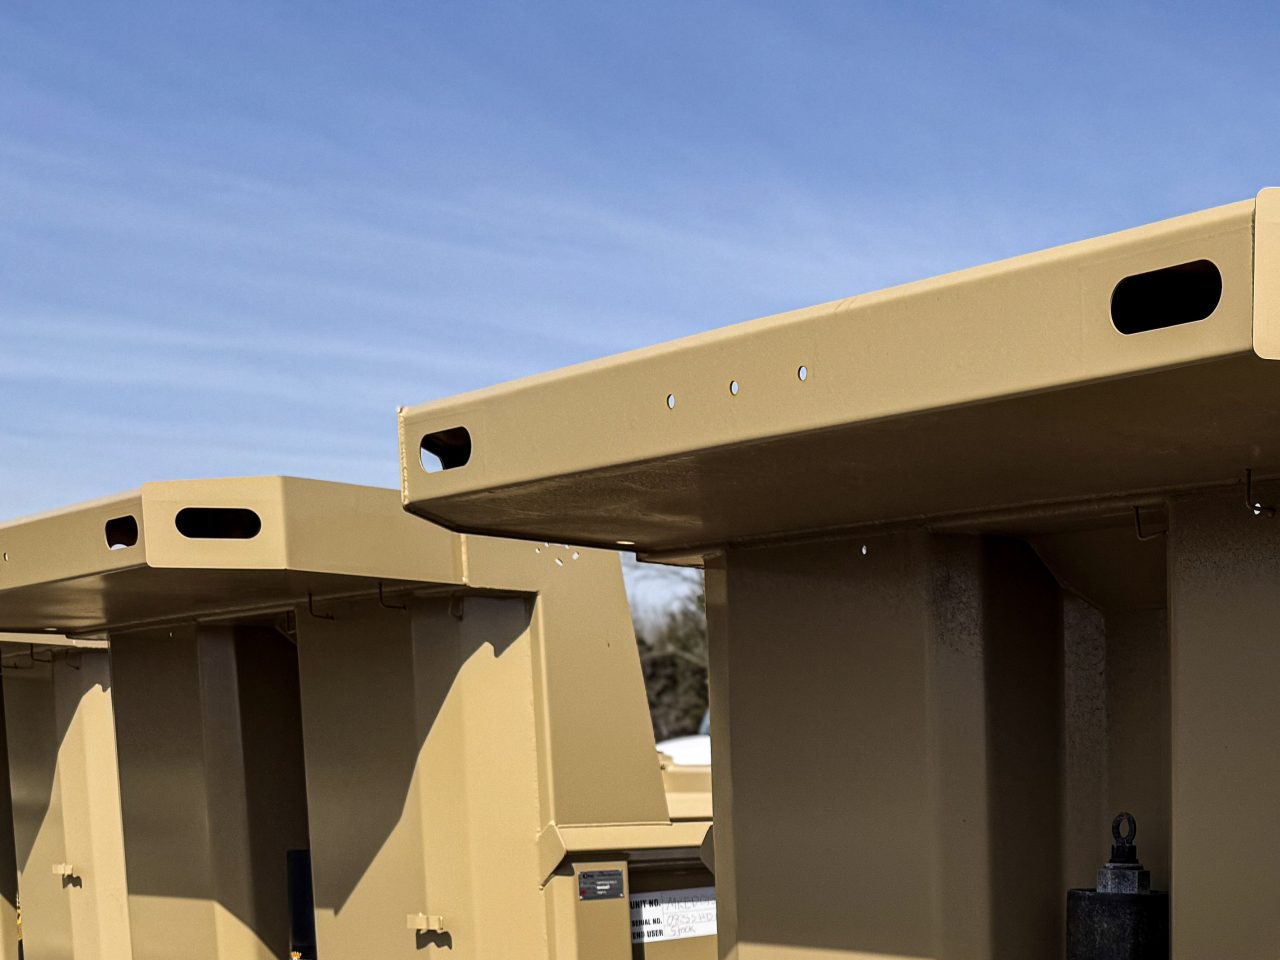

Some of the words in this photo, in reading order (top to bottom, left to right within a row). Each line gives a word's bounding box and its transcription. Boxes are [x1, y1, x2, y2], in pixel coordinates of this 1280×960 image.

[630, 900, 648, 910] UNIT
[631, 917, 651, 928] SERIAL
[652, 917, 663, 926] NO.
[632, 930, 645, 940] END
[646, 929, 664, 939] USER
